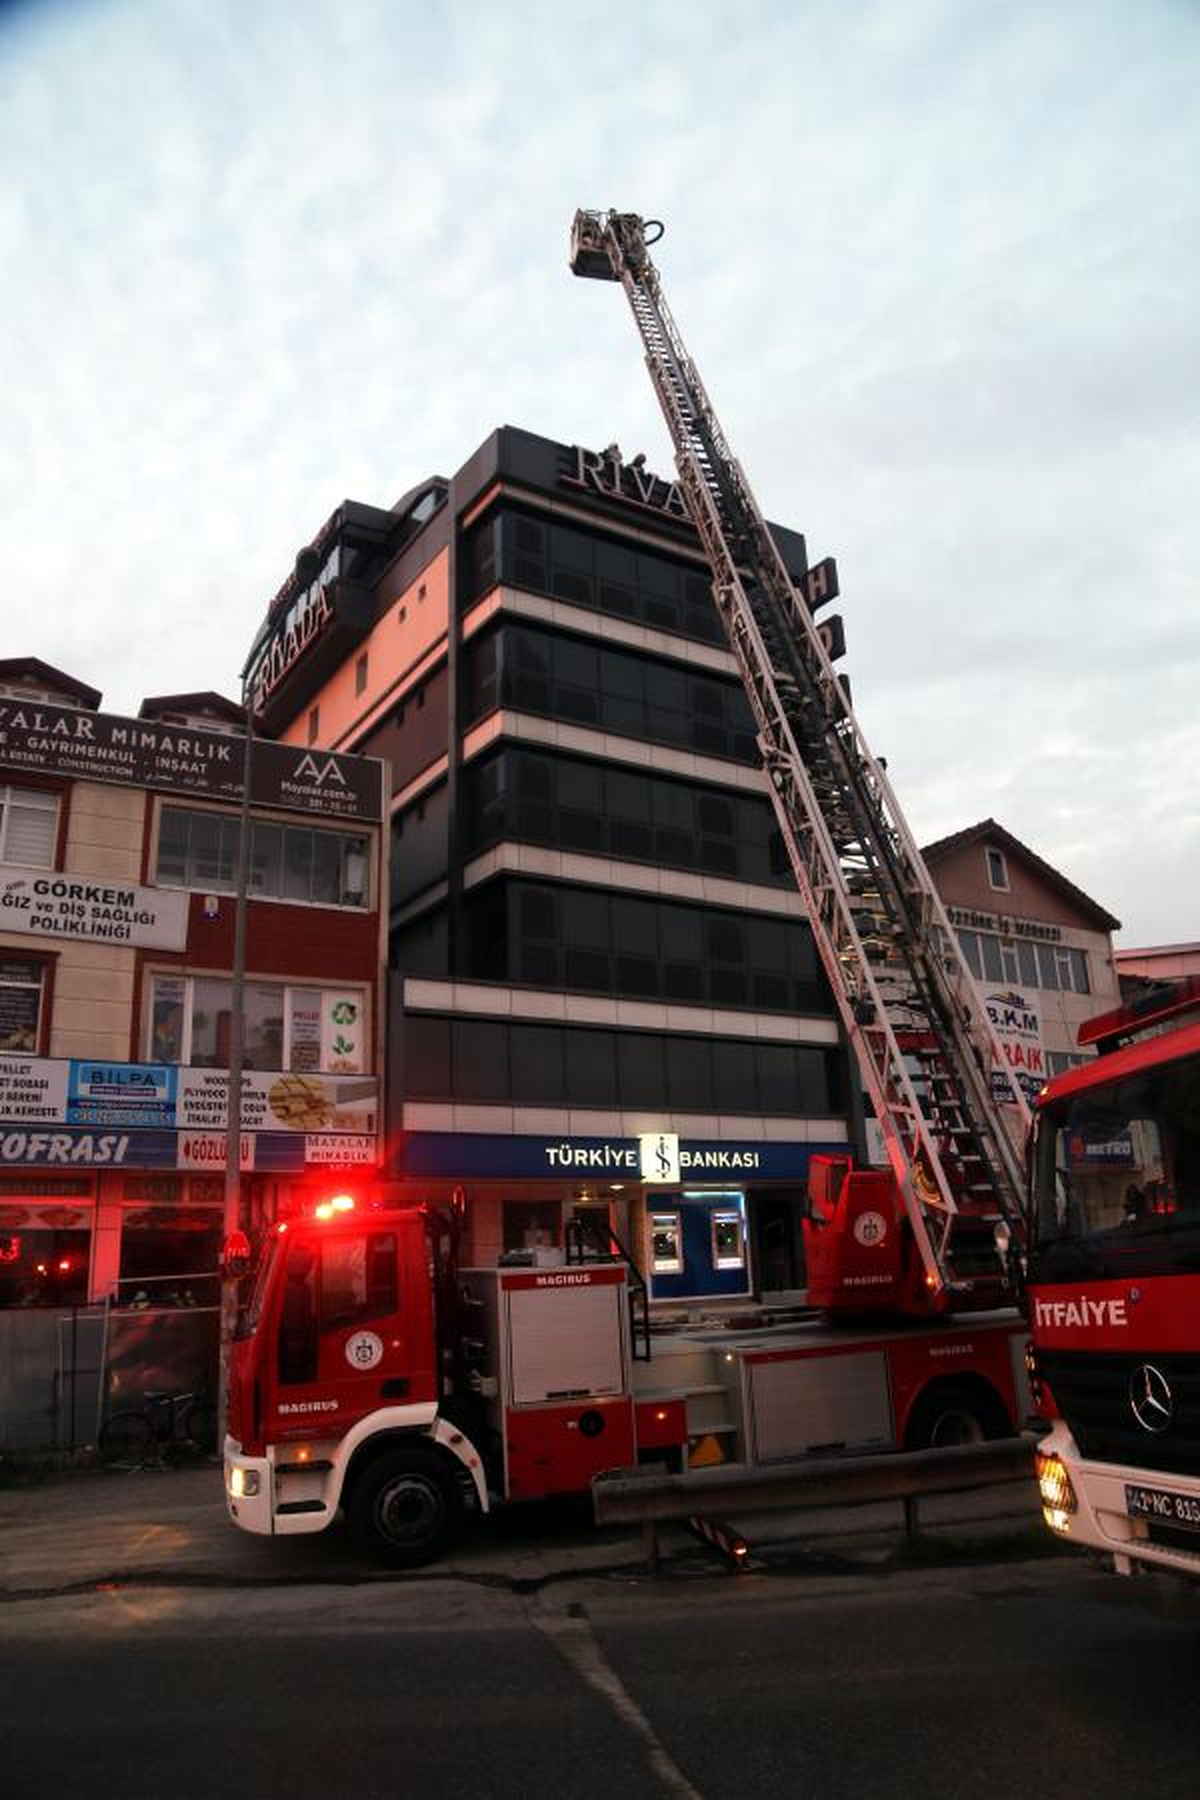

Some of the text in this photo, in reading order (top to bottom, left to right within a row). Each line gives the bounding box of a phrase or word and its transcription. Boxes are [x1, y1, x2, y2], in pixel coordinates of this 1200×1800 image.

[34, 879, 135, 908] GÖRKEM
[0, 894, 156, 926] ĞIZ ve DİŞ SAĞLIĞI
[30, 915, 131, 939] POLİKLİNİĞİ
[91, 1067, 156, 1086] BİLPA
[546, 1145, 638, 1168] TÜRKİYE
[680, 1152, 760, 1168] BANKASI
[537, 1273, 591, 1285] MAGIRUS
[278, 1400, 338, 1415] MAGIRUS
